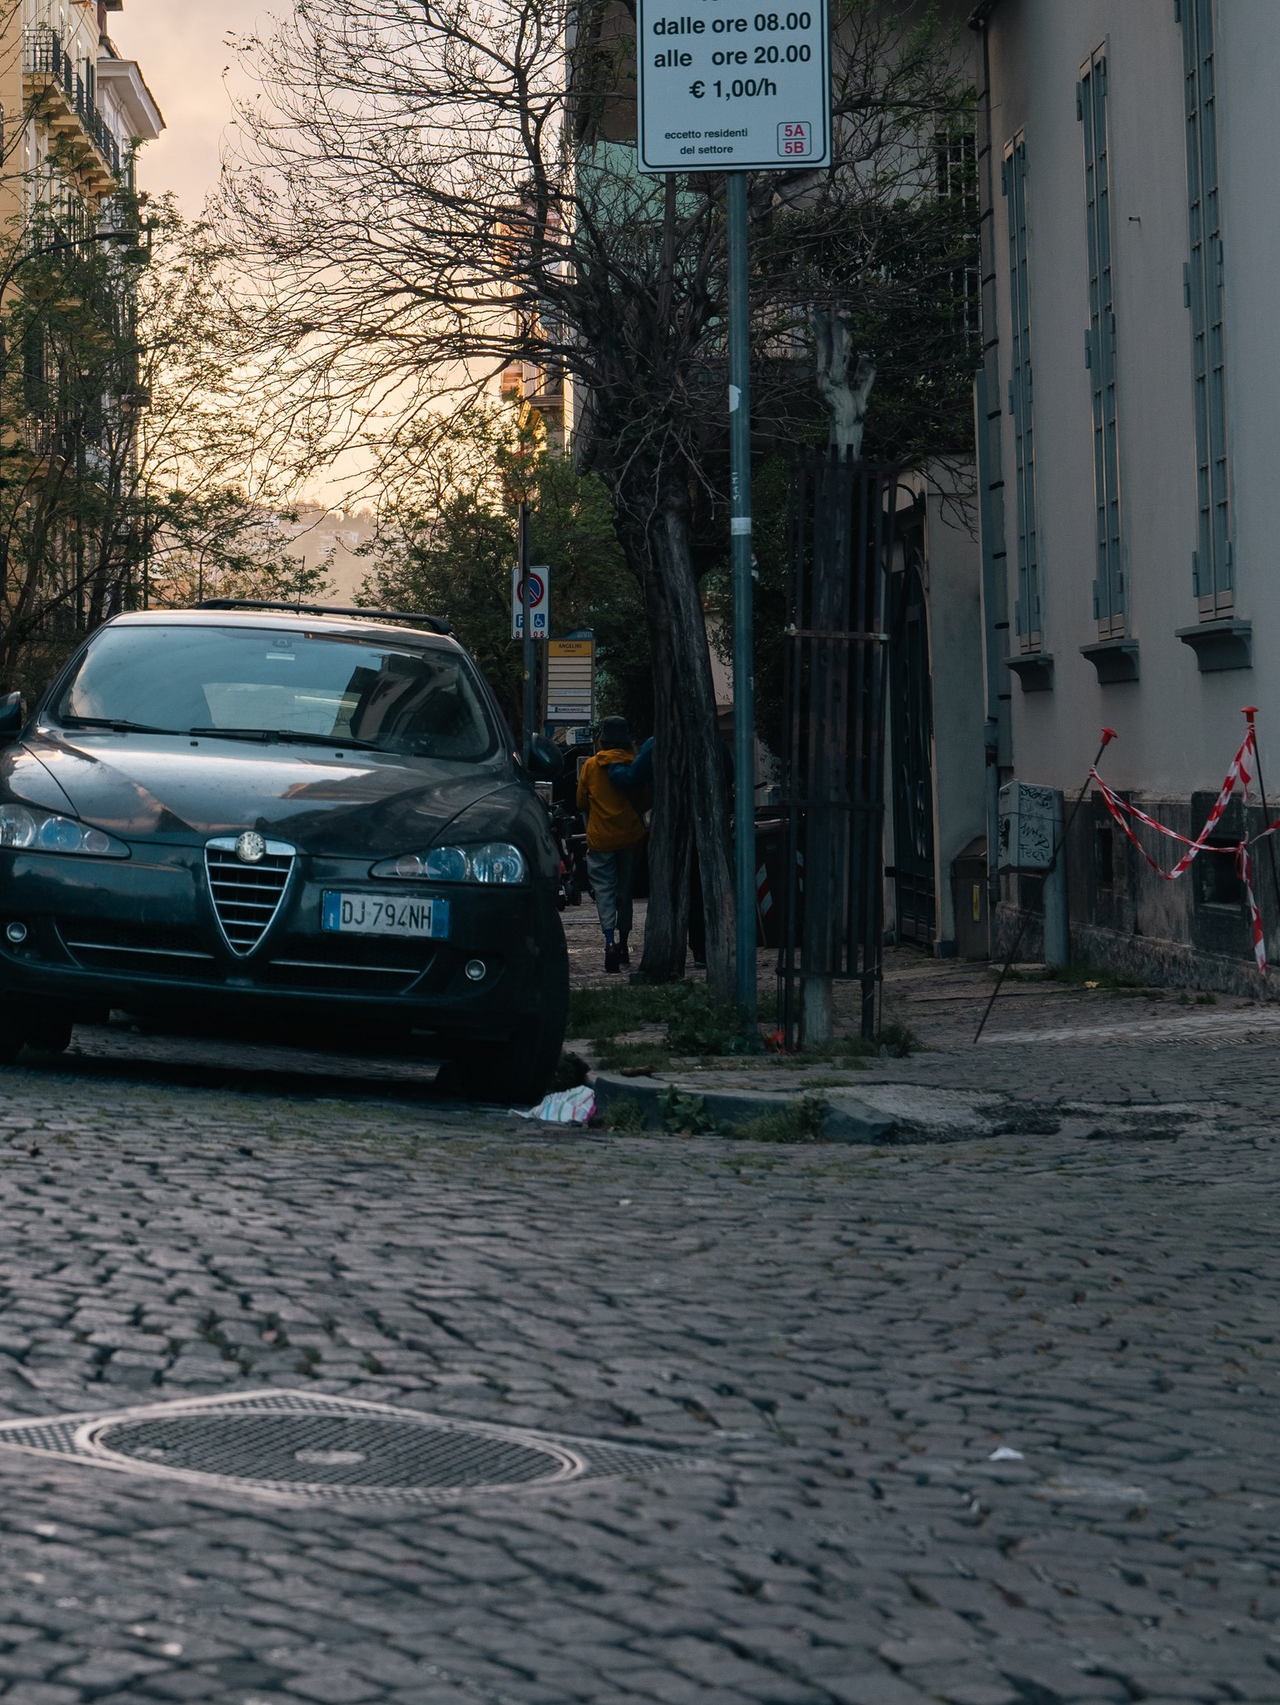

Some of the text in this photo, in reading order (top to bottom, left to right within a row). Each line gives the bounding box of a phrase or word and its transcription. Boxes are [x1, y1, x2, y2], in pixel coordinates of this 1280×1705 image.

[652, 11, 812, 36] dalle ore 08.00
[653, 44, 812, 68] alle ore 20.00
[688, 77, 777, 101] € 1,00/h
[664, 128, 748, 140] eccetto residenti
[784, 124, 805, 137] 5A
[679, 144, 734, 155] del settore
[784, 141, 805, 154] 5B
